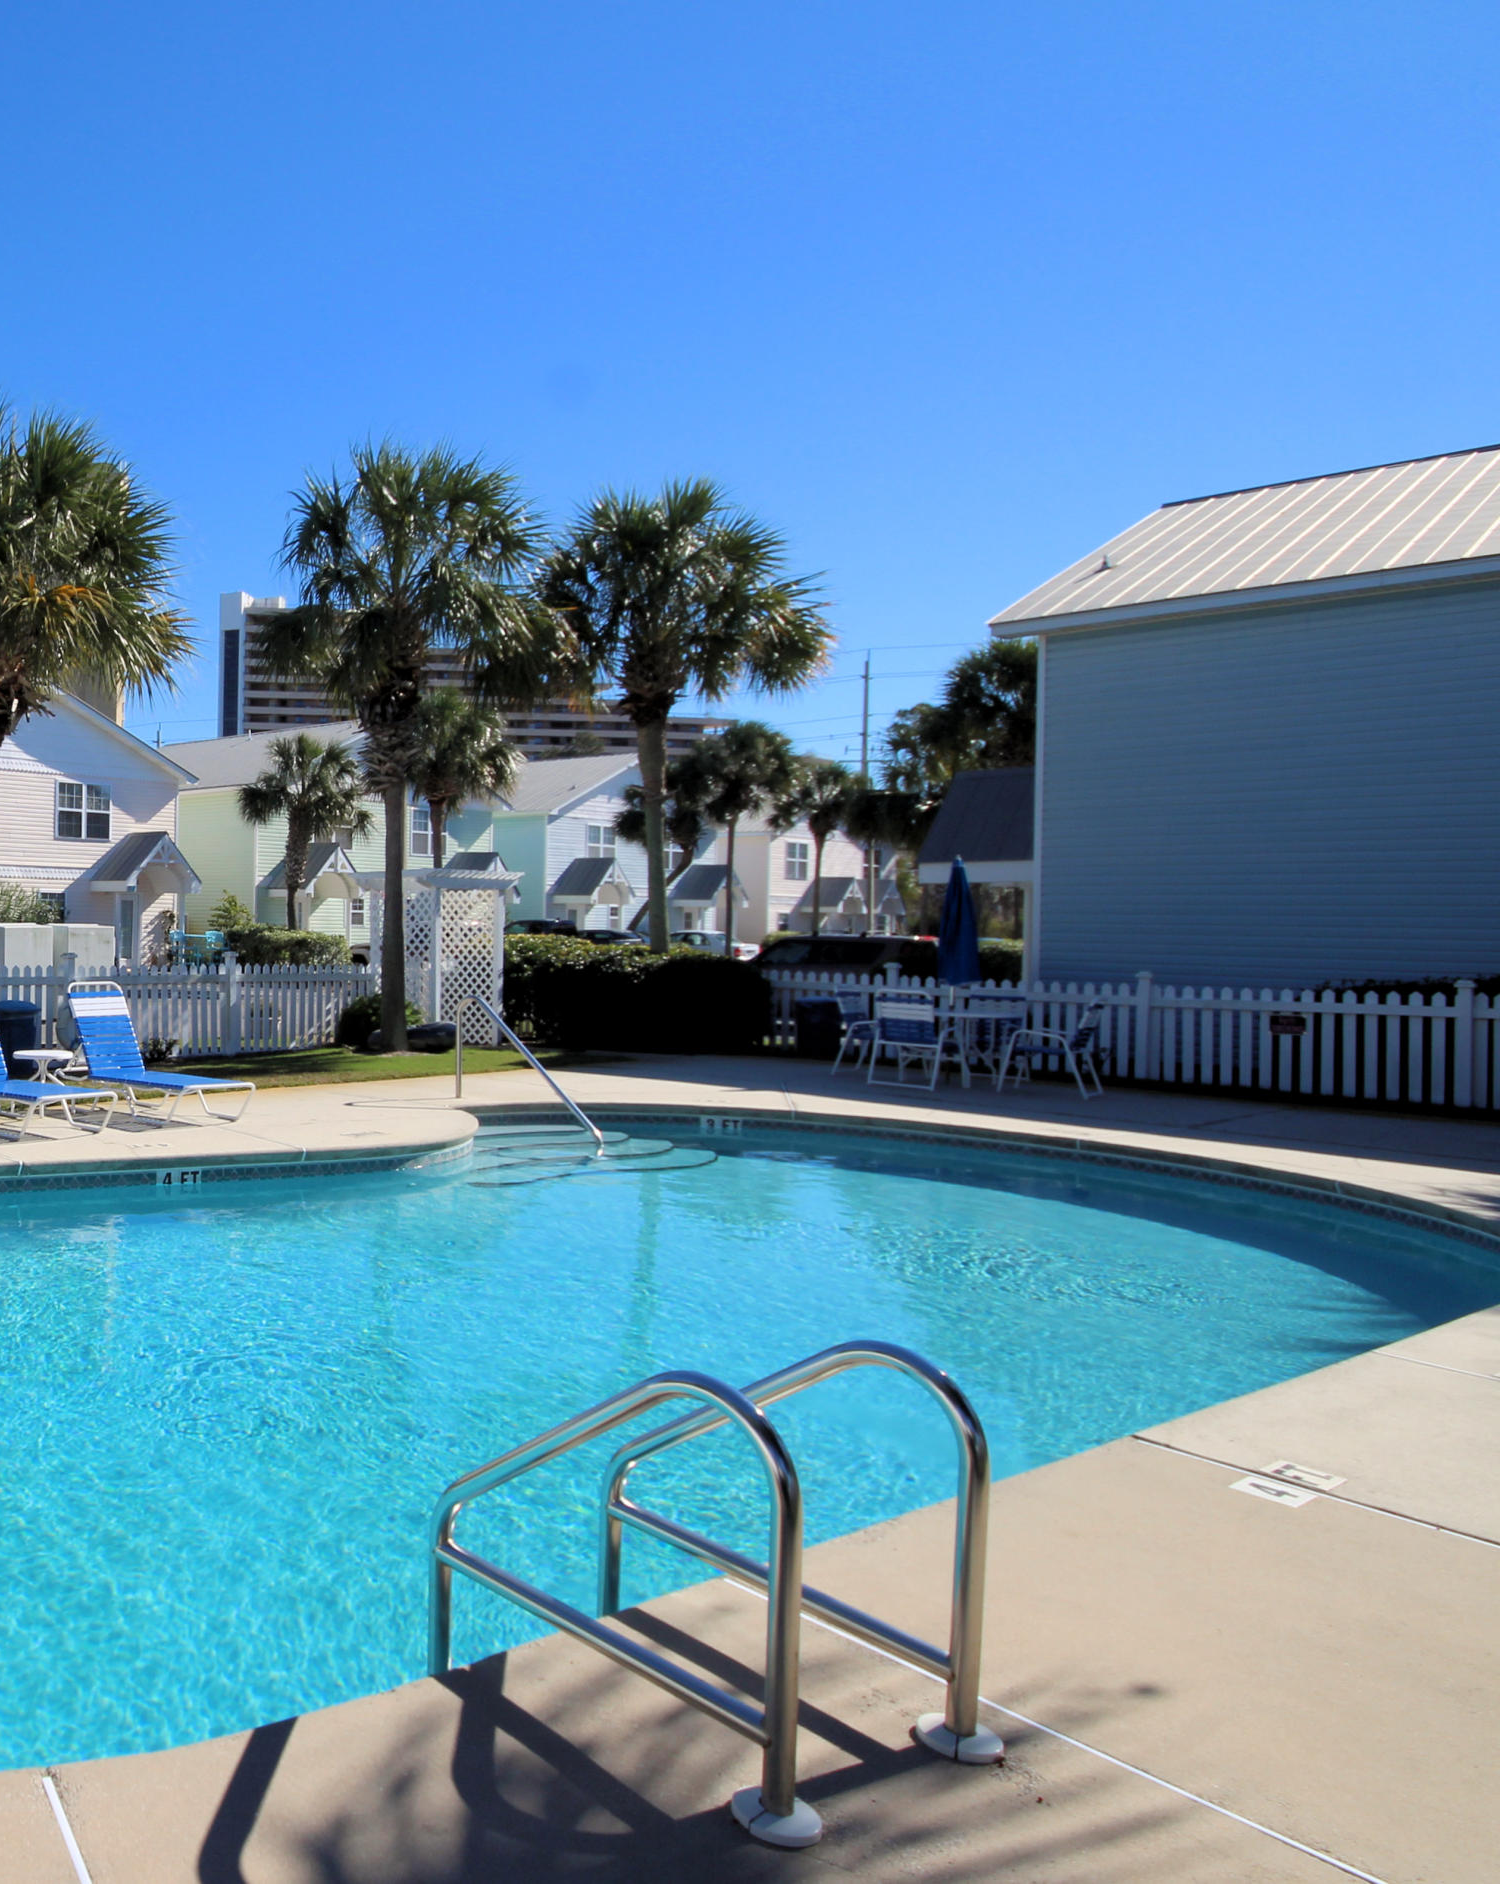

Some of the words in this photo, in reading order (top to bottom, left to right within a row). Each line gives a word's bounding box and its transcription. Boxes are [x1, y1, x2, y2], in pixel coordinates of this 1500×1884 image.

[706, 1118, 716, 1128] 3
[722, 1119, 741, 1128] FT
[162, 1172, 172, 1185] 4
[180, 1171, 200, 1184] FT
[1248, 1481, 1299, 1498] 4
